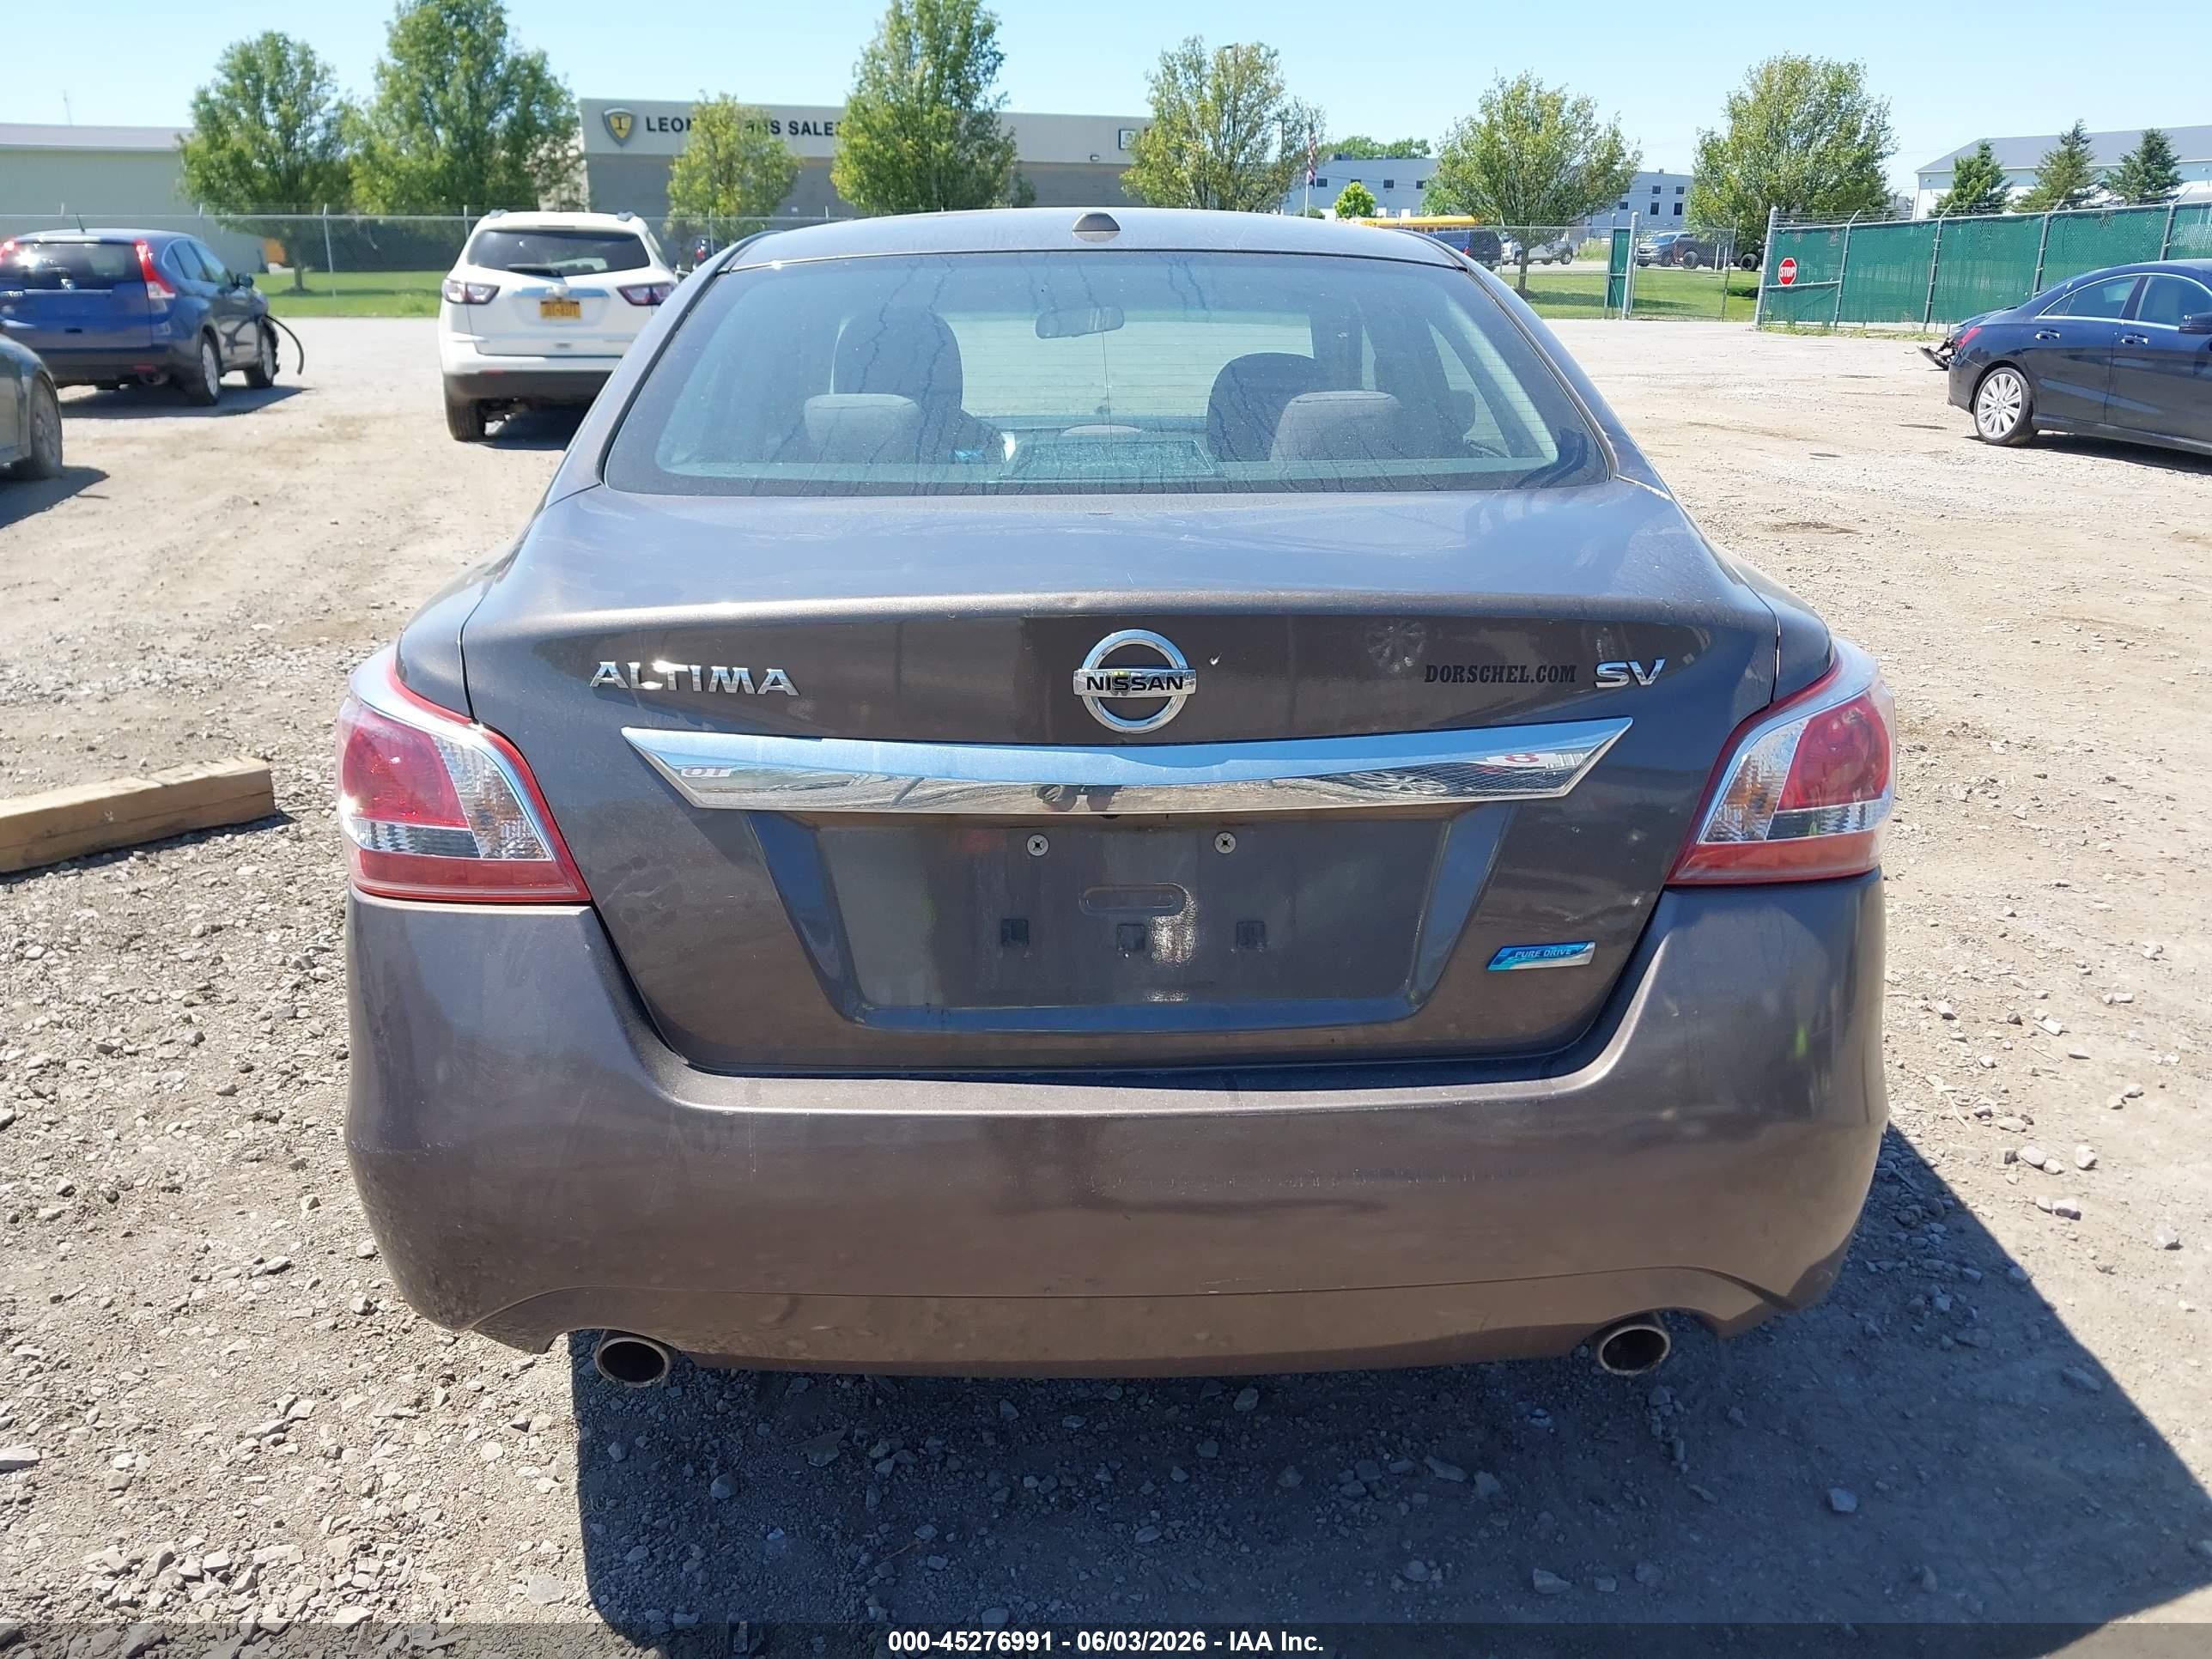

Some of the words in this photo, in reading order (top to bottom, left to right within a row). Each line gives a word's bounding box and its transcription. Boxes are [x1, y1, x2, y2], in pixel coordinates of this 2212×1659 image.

[1779, 266, 1796, 277] STOP
[590, 660, 799, 696] ALTIMA
[1425, 665, 1577, 684] DORSCHEL.COM
[1594, 658, 1668, 689] SV
[1086, 677, 1184, 691] NISSAN
[1514, 950, 1541, 958] PURE
[1543, 948, 1572, 957] DRIVE
